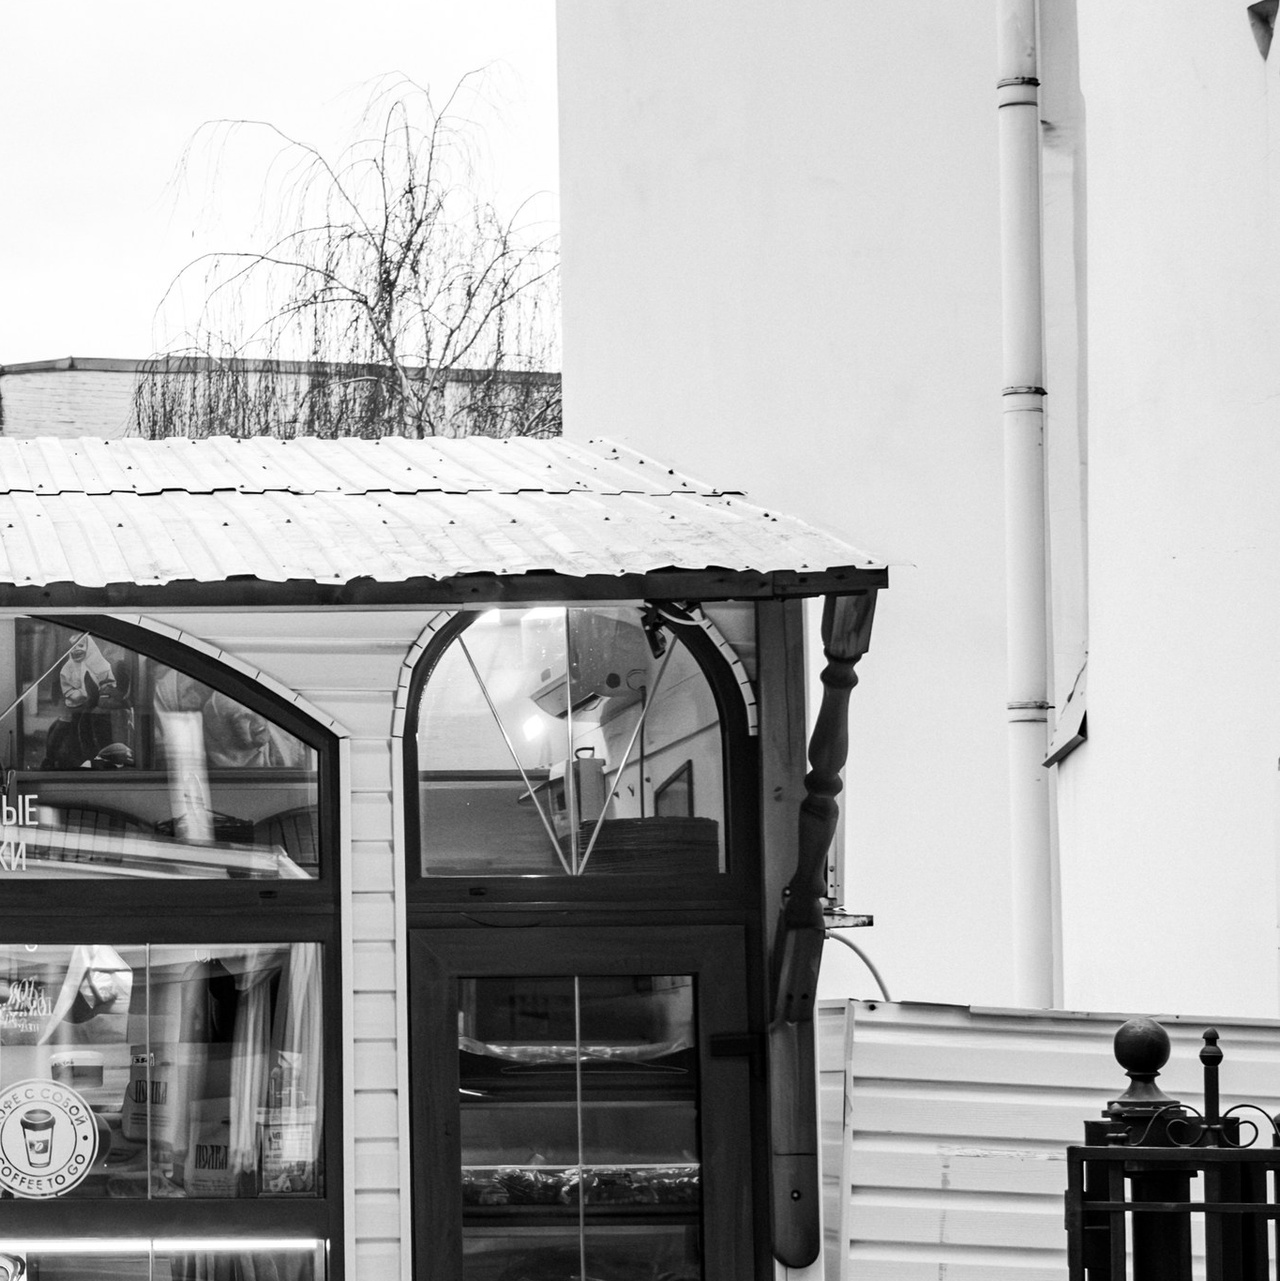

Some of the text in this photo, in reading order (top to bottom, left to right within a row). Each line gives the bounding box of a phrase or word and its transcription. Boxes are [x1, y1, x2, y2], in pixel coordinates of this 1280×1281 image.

[24, 1088, 35, 1099] С
[40, 1088, 88, 1126] СОБОЙ
[47, 1174, 65, 1189] TO
[67, 1154, 85, 1175] GO
